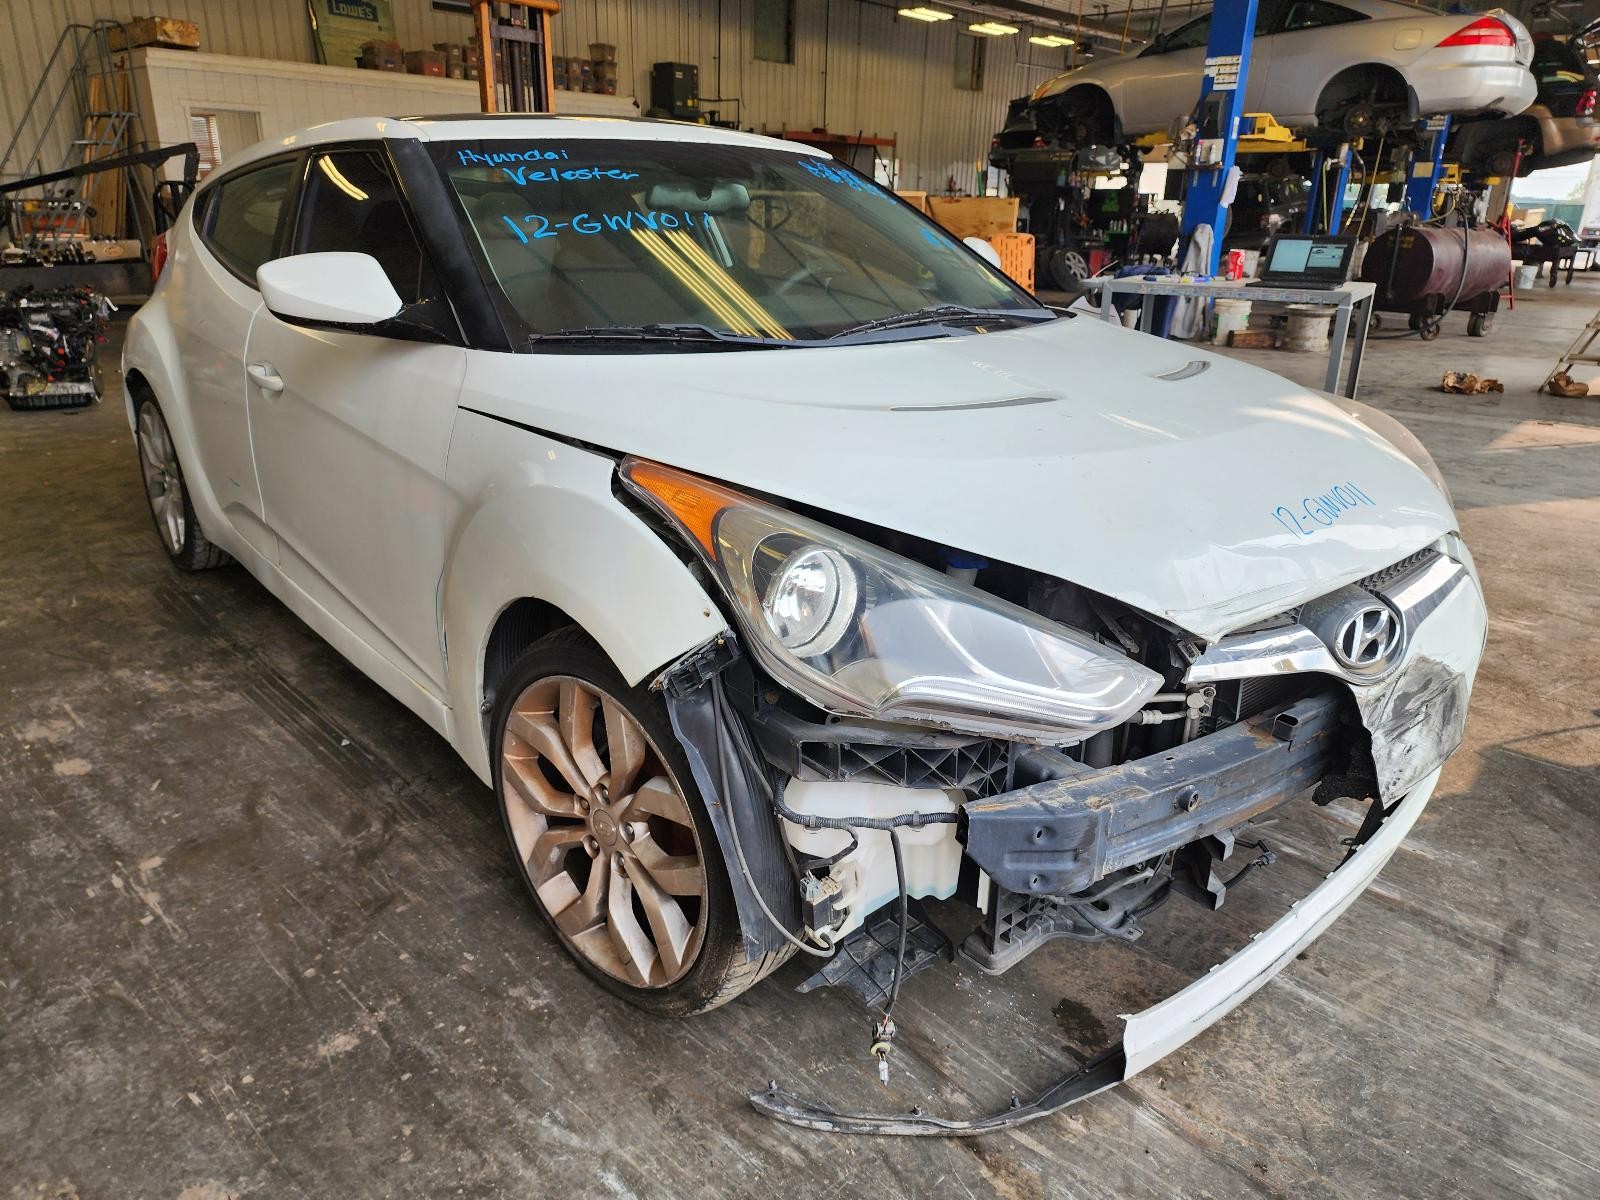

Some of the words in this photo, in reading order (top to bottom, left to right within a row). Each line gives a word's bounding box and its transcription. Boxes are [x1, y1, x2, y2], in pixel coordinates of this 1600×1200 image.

[333, 0, 374, 20] LOWE'S
[458, 150, 569, 167] Hyundai
[502, 167, 640, 186] Veloster
